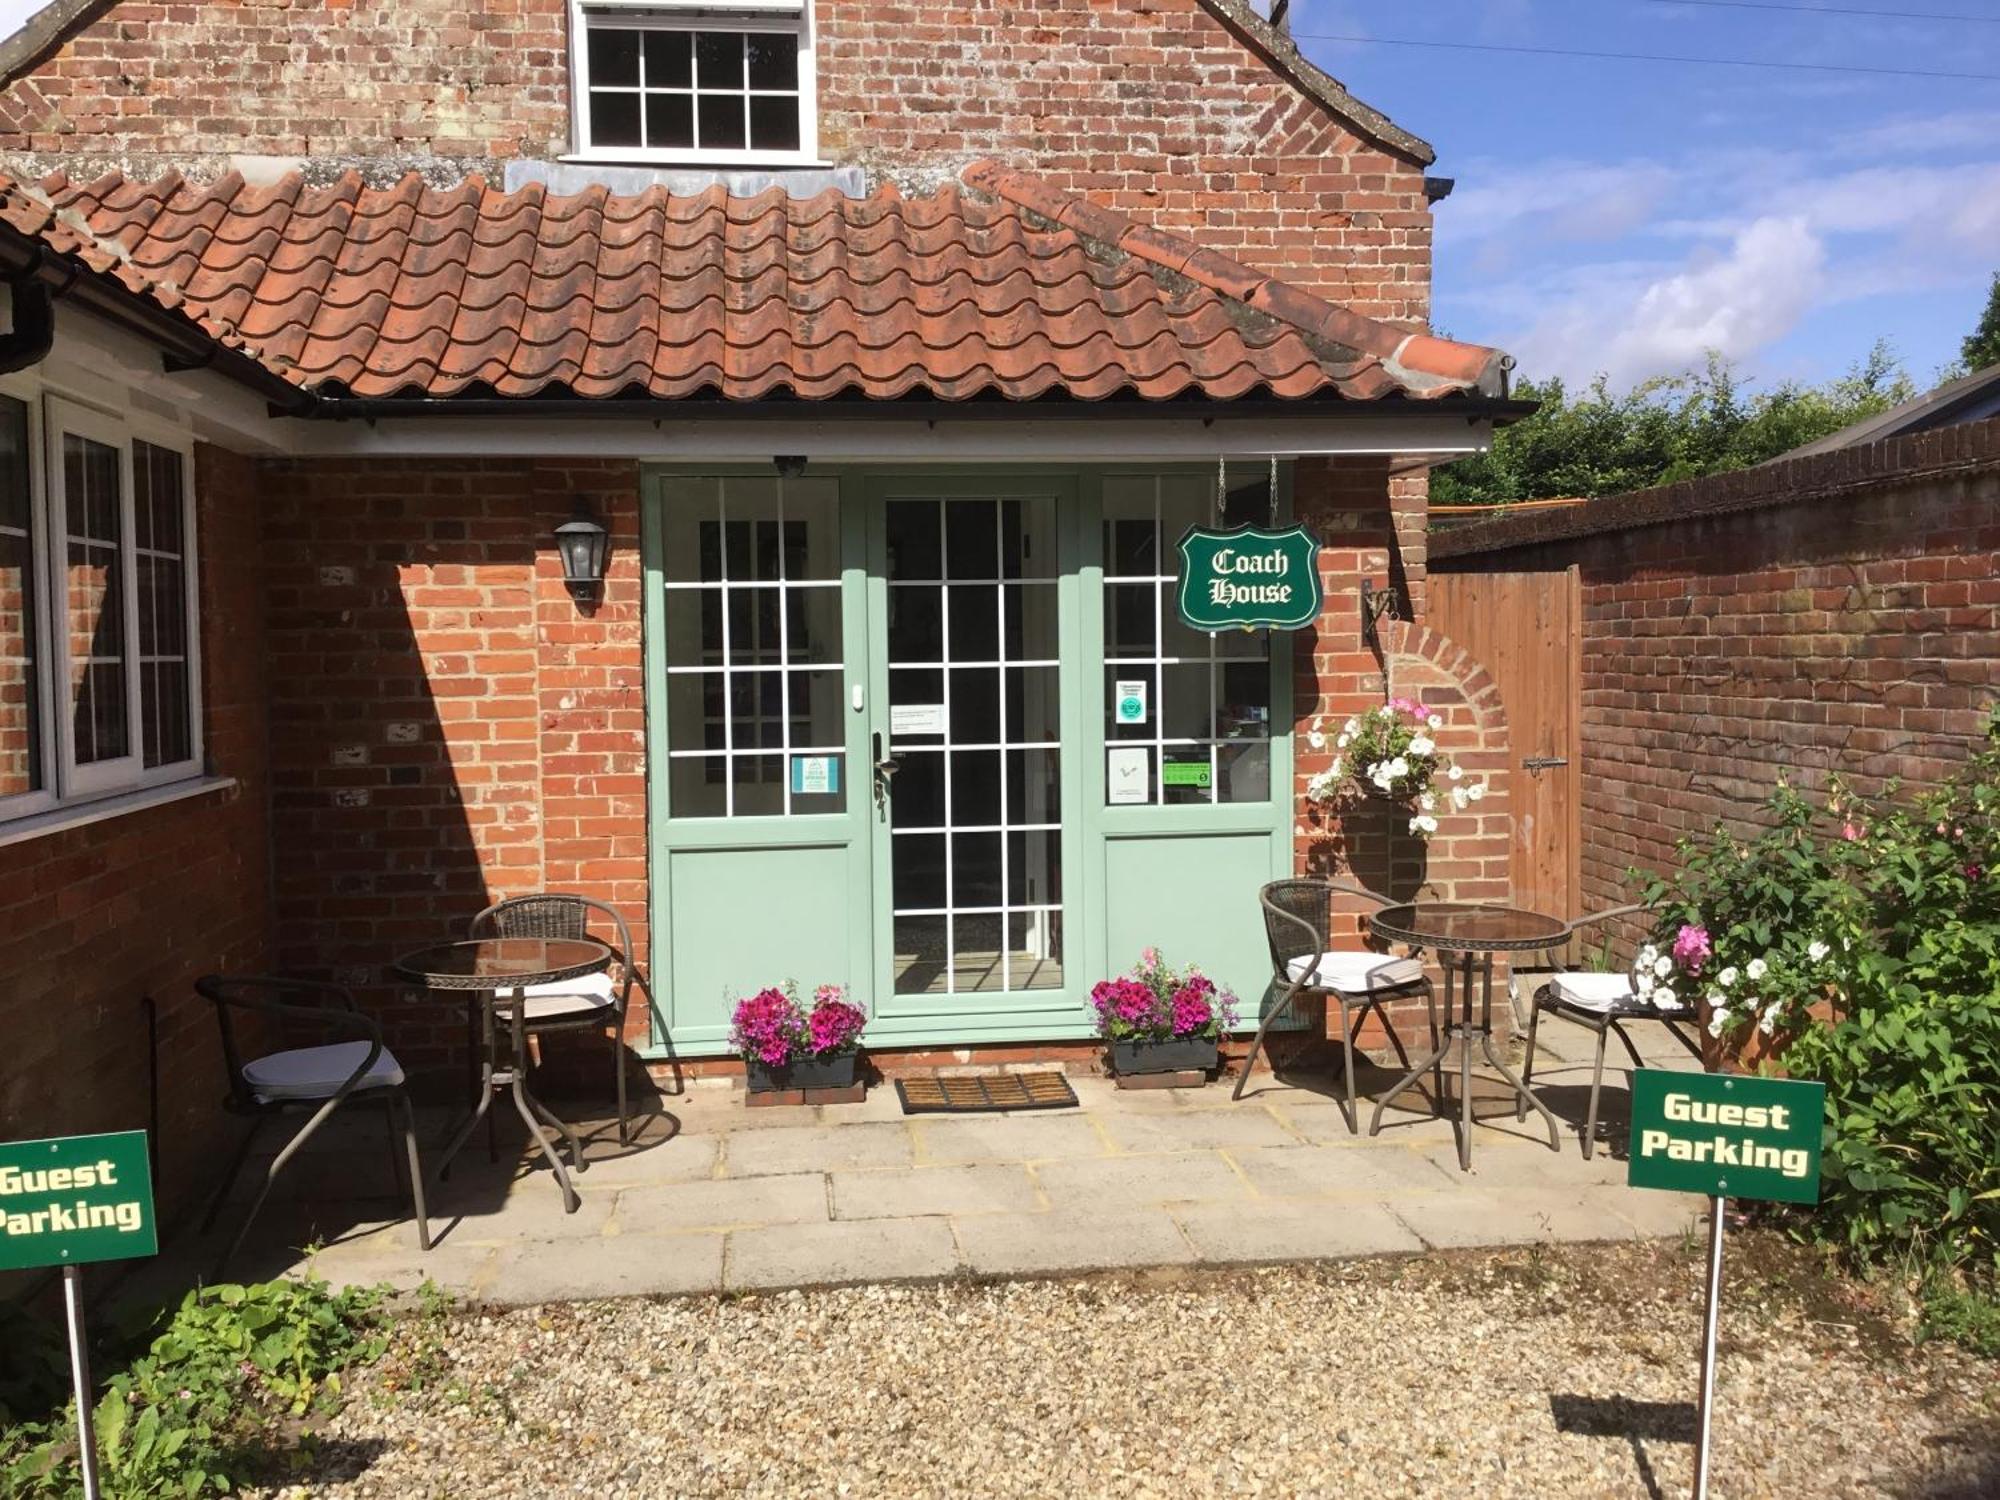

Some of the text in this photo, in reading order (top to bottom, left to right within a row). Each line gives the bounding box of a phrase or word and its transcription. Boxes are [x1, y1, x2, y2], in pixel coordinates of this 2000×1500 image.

[1212, 548, 1289, 578] Coach
[1208, 578, 1292, 609] House
[1663, 1093, 1790, 1130] Guest
[1641, 1130, 1809, 1178] Parking
[0, 1160, 118, 1195] Guest
